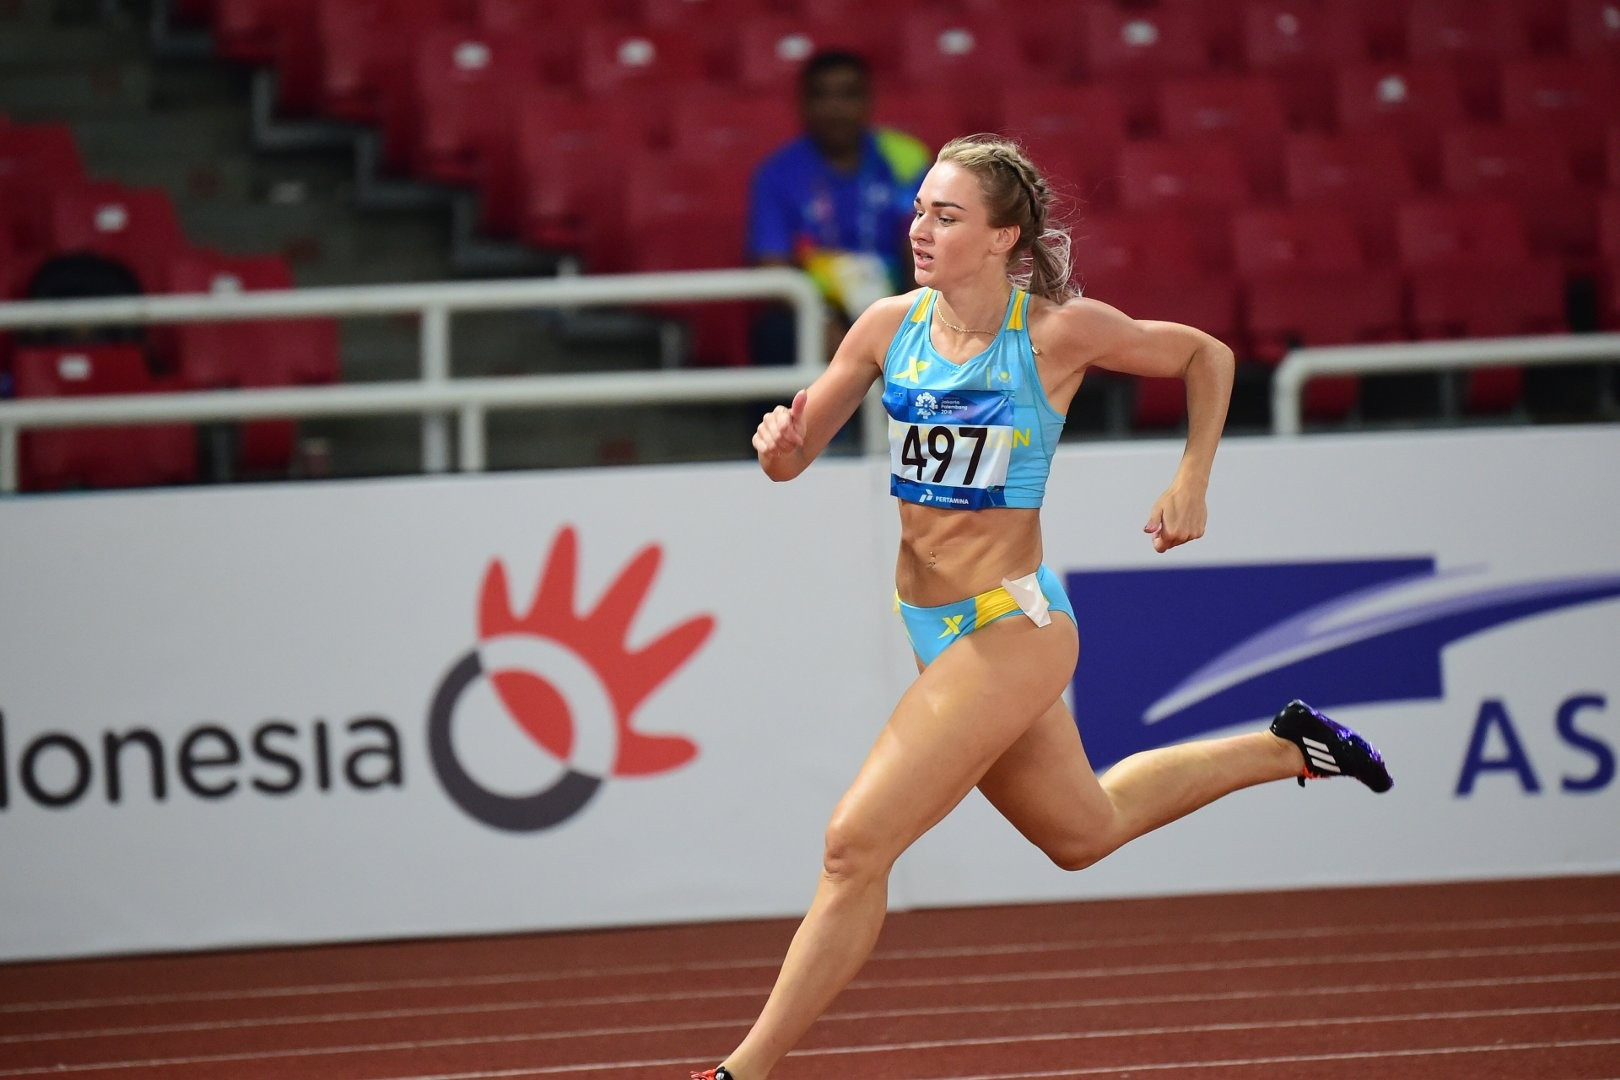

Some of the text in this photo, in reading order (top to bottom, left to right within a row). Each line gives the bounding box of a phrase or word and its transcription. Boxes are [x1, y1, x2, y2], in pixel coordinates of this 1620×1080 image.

[901, 425, 988, 485] 497
[935, 496, 969, 505] PERTAMINA
[1455, 693, 1617, 797] AS
